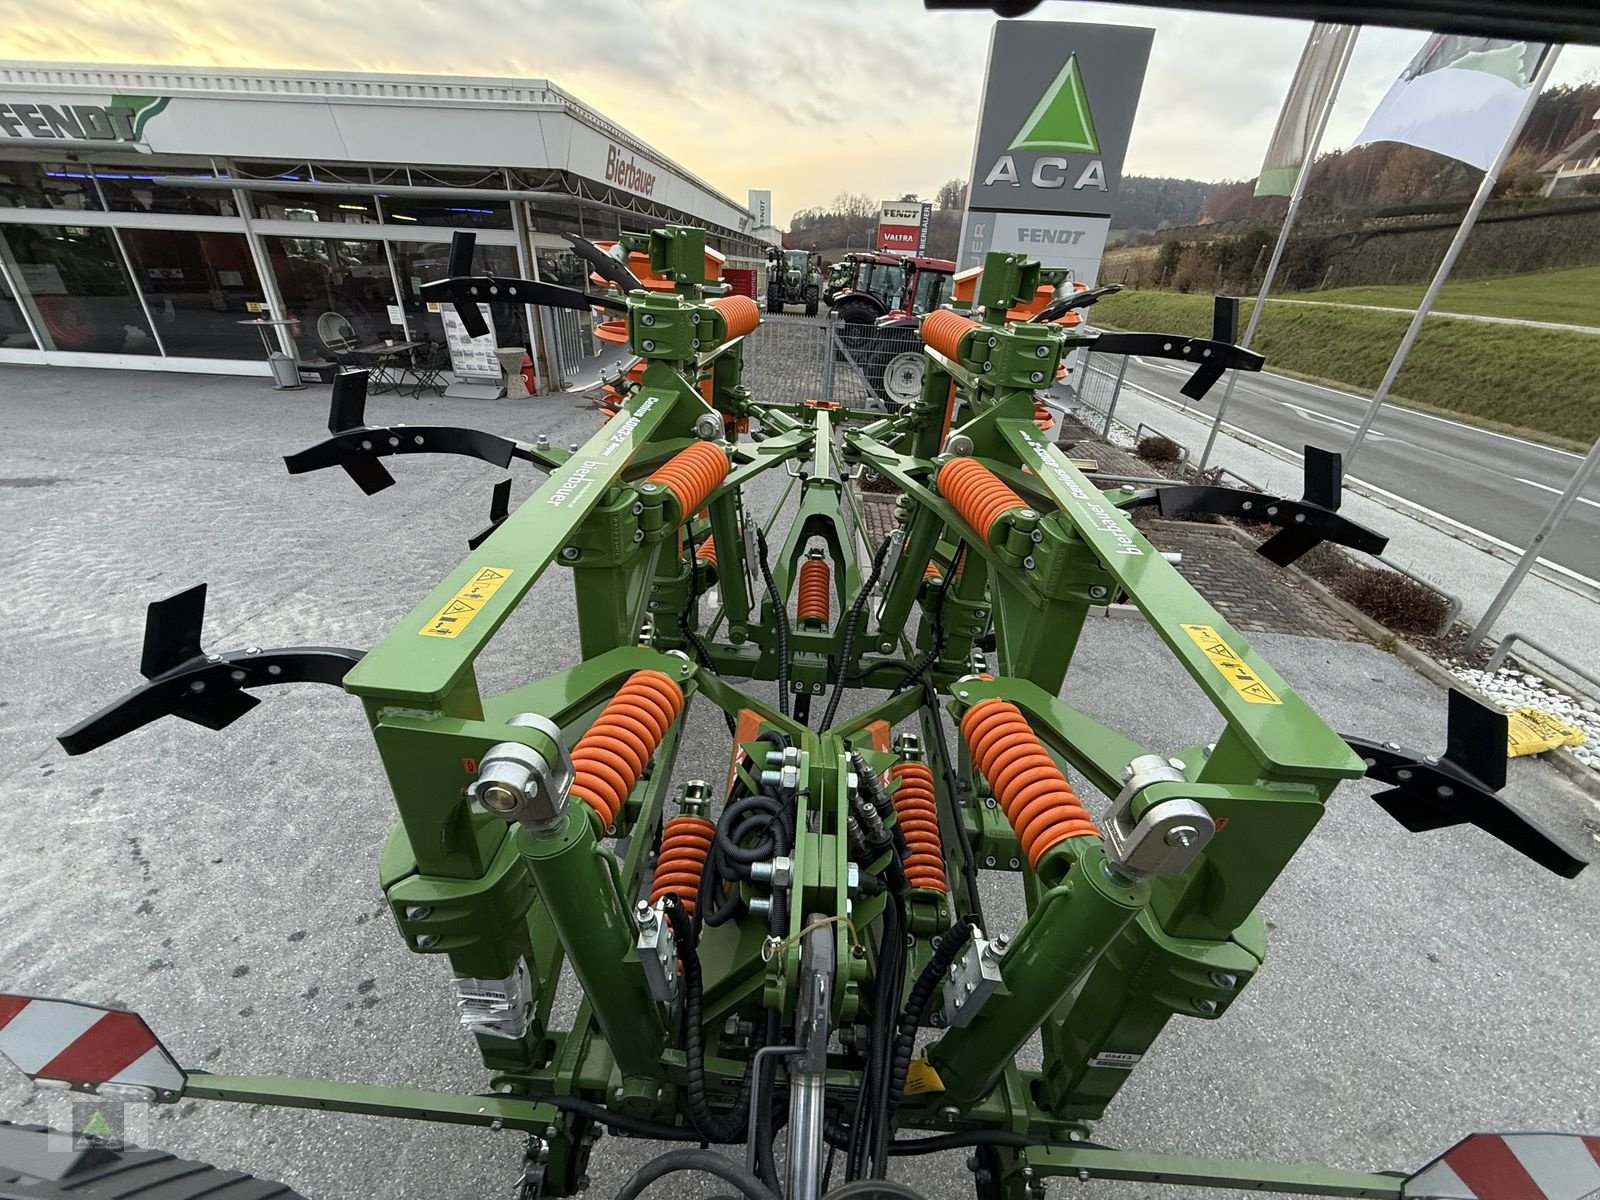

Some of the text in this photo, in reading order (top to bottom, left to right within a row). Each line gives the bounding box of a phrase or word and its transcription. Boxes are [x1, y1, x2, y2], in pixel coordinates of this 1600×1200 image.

[0, 103, 137, 141] FENDT
[605, 144, 656, 196] Bierbauer
[982, 155, 1109, 192] ACA
[884, 209, 919, 218] FENDT
[919, 206, 930, 250] BIERBAUER
[884, 233, 914, 242] VALTRA
[1017, 227, 1086, 245] FENDT
[546, 459, 609, 508] bierbauer
[1089, 504, 1144, 556] bierbauer
